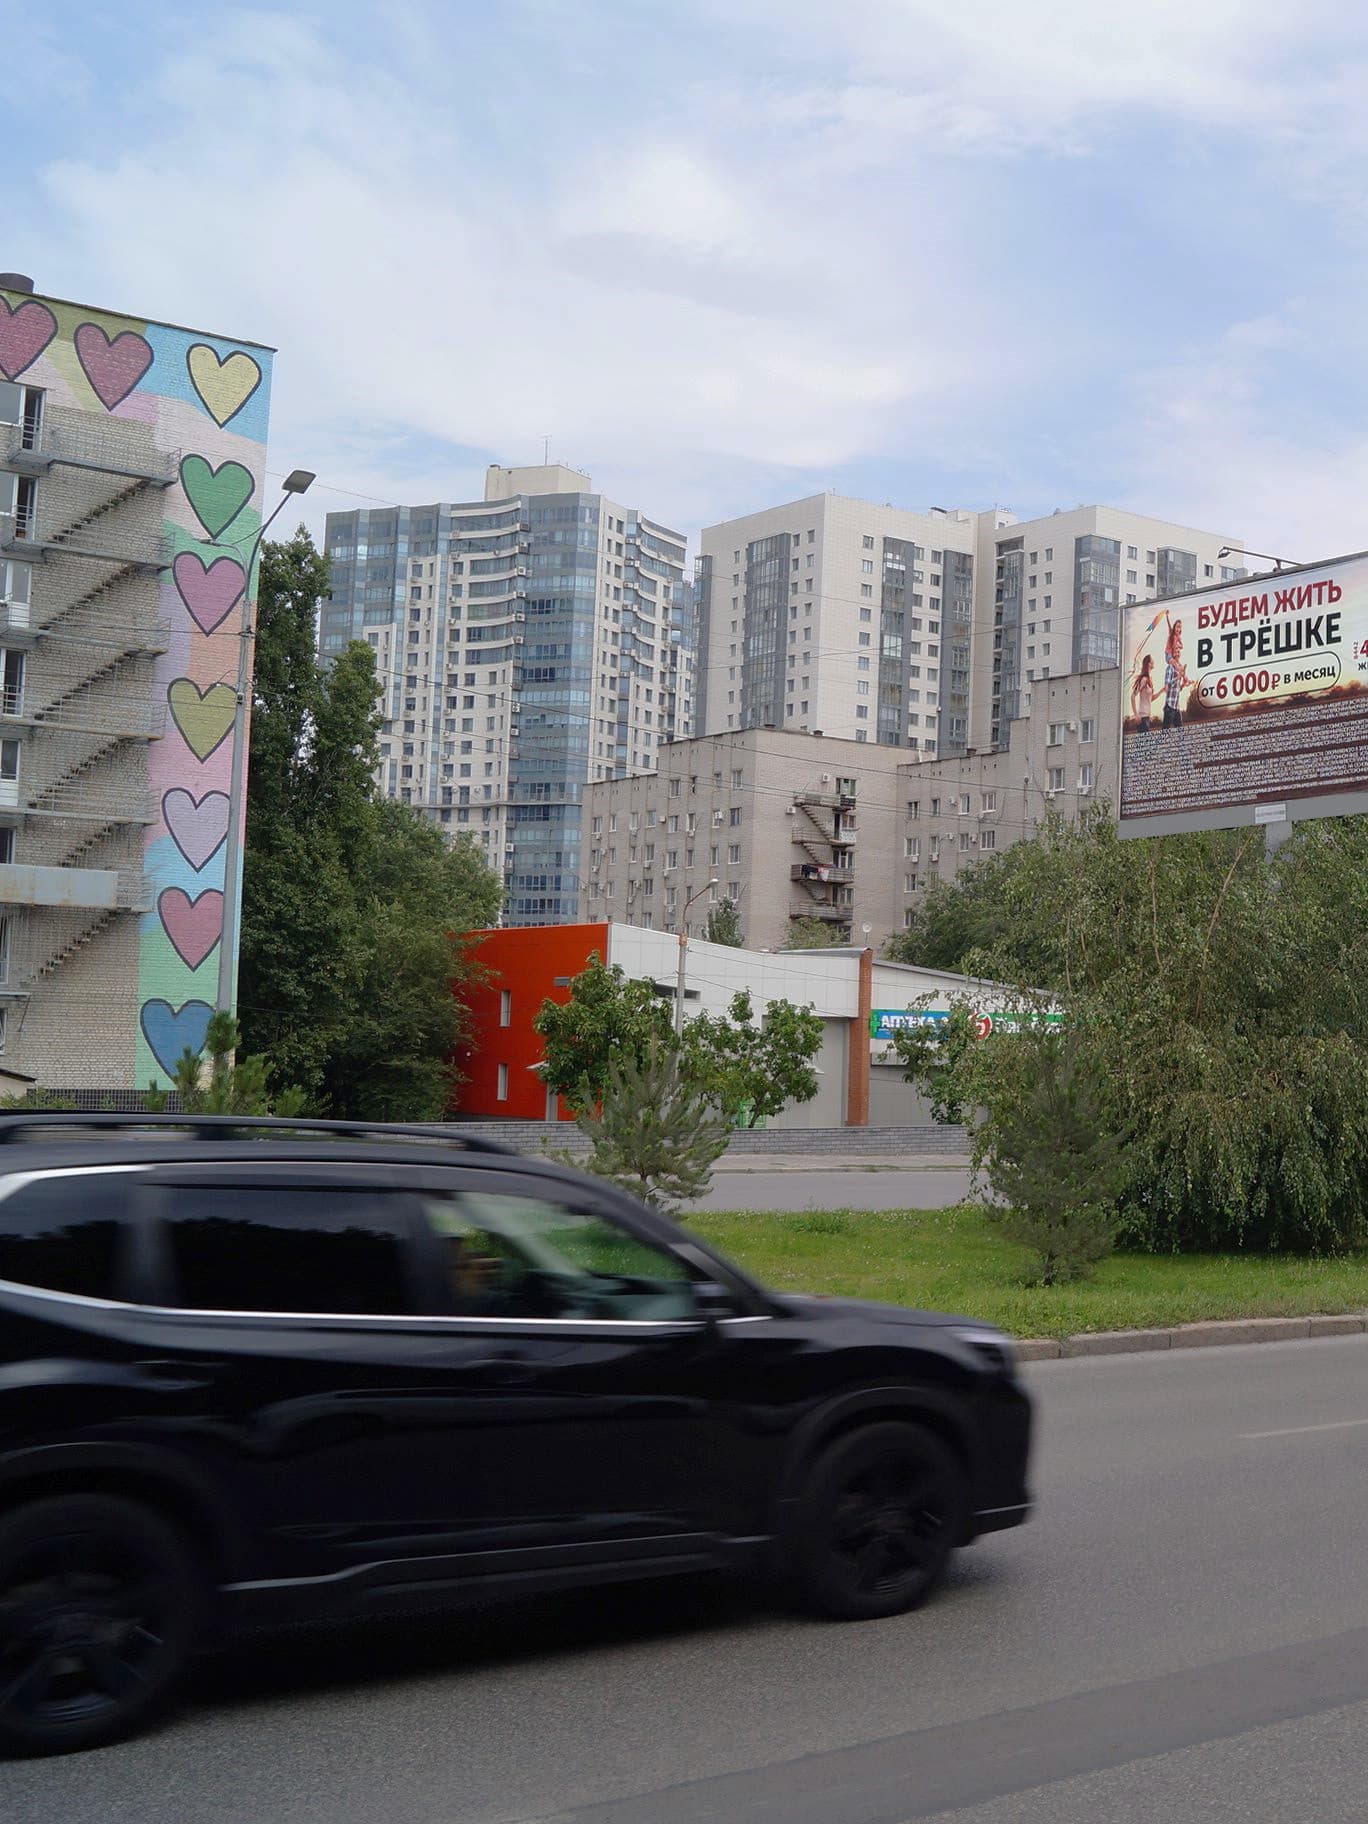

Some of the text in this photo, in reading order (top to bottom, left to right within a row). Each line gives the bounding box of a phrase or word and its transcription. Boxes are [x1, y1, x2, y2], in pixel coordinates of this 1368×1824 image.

[1197, 579, 1342, 630] БУДЕМ ЖИТЬ
[1197, 612, 1342, 669] В ТРЁШКЕ
[1294, 665, 1336, 683] месяц
